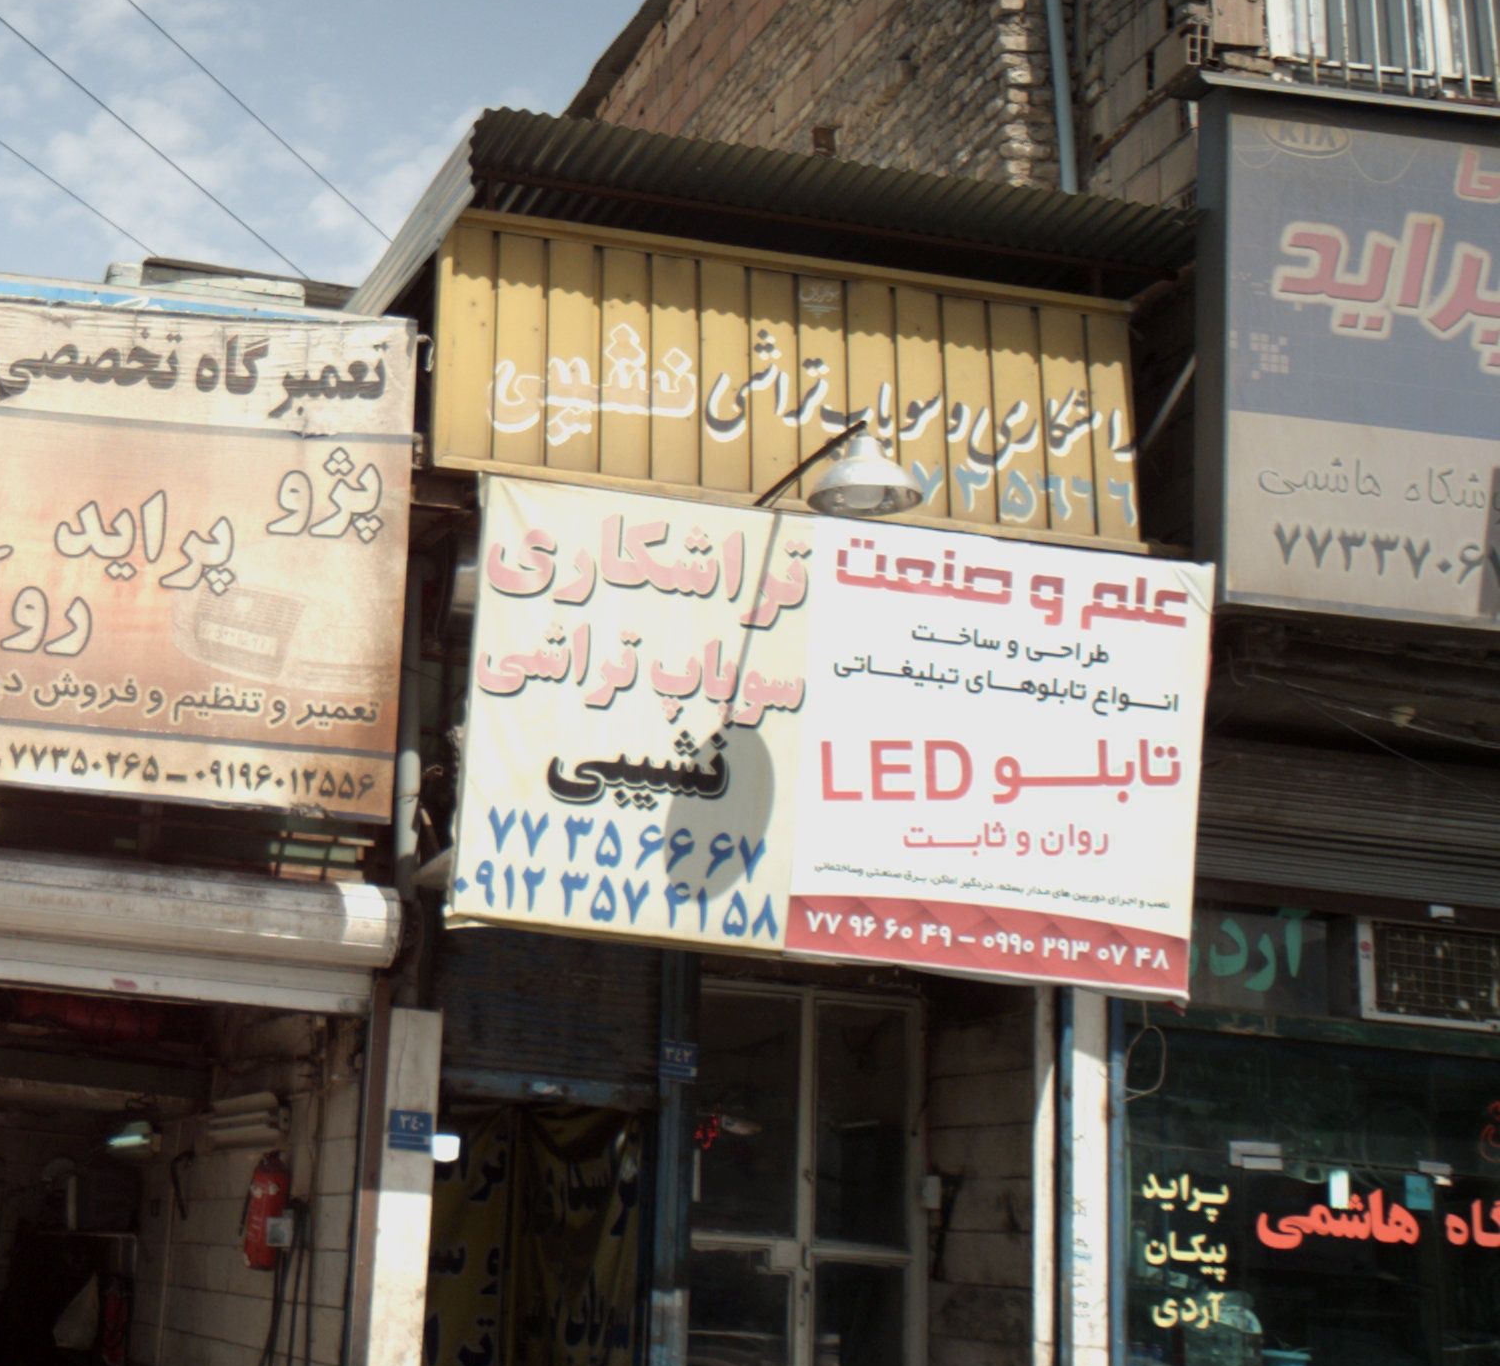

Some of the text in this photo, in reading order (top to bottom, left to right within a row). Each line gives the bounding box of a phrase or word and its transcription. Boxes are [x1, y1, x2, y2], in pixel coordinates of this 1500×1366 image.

[706, 329, 829, 443] تراشی
[265, 446, 384, 543] پژو
[1257, 457, 1382, 496] هاشمی
[53, 488, 237, 596] پراید
[486, 513, 812, 631] تراشکاری
[835, 537, 1189, 631] علم و صنعت
[476, 621, 807, 727] سوپاپ تراشی
[911, 624, 1111, 669] طراحی و ساخت
[33, 671, 138, 709] فروش
[146, 688, 164, 714] و
[173, 686, 262, 721] تنظیم
[269, 697, 288, 724] و
[296, 700, 379, 727] تعمیر
[834, 654, 1179, 716] انواع تابلوهای تبلیغاتی
[547, 730, 729, 811] نشیبی
[820, 738, 1183, 805] تابلو LED
[903, 821, 1110, 857] روان و ثابت
[1188, 908, 1312, 991] آرد
[1141, 1173, 1229, 1223] پراید
[1256, 1188, 1420, 1249] هاشمی
[1144, 1230, 1228, 1283] پیکان
[1152, 1291, 1225, 1329] آردی
